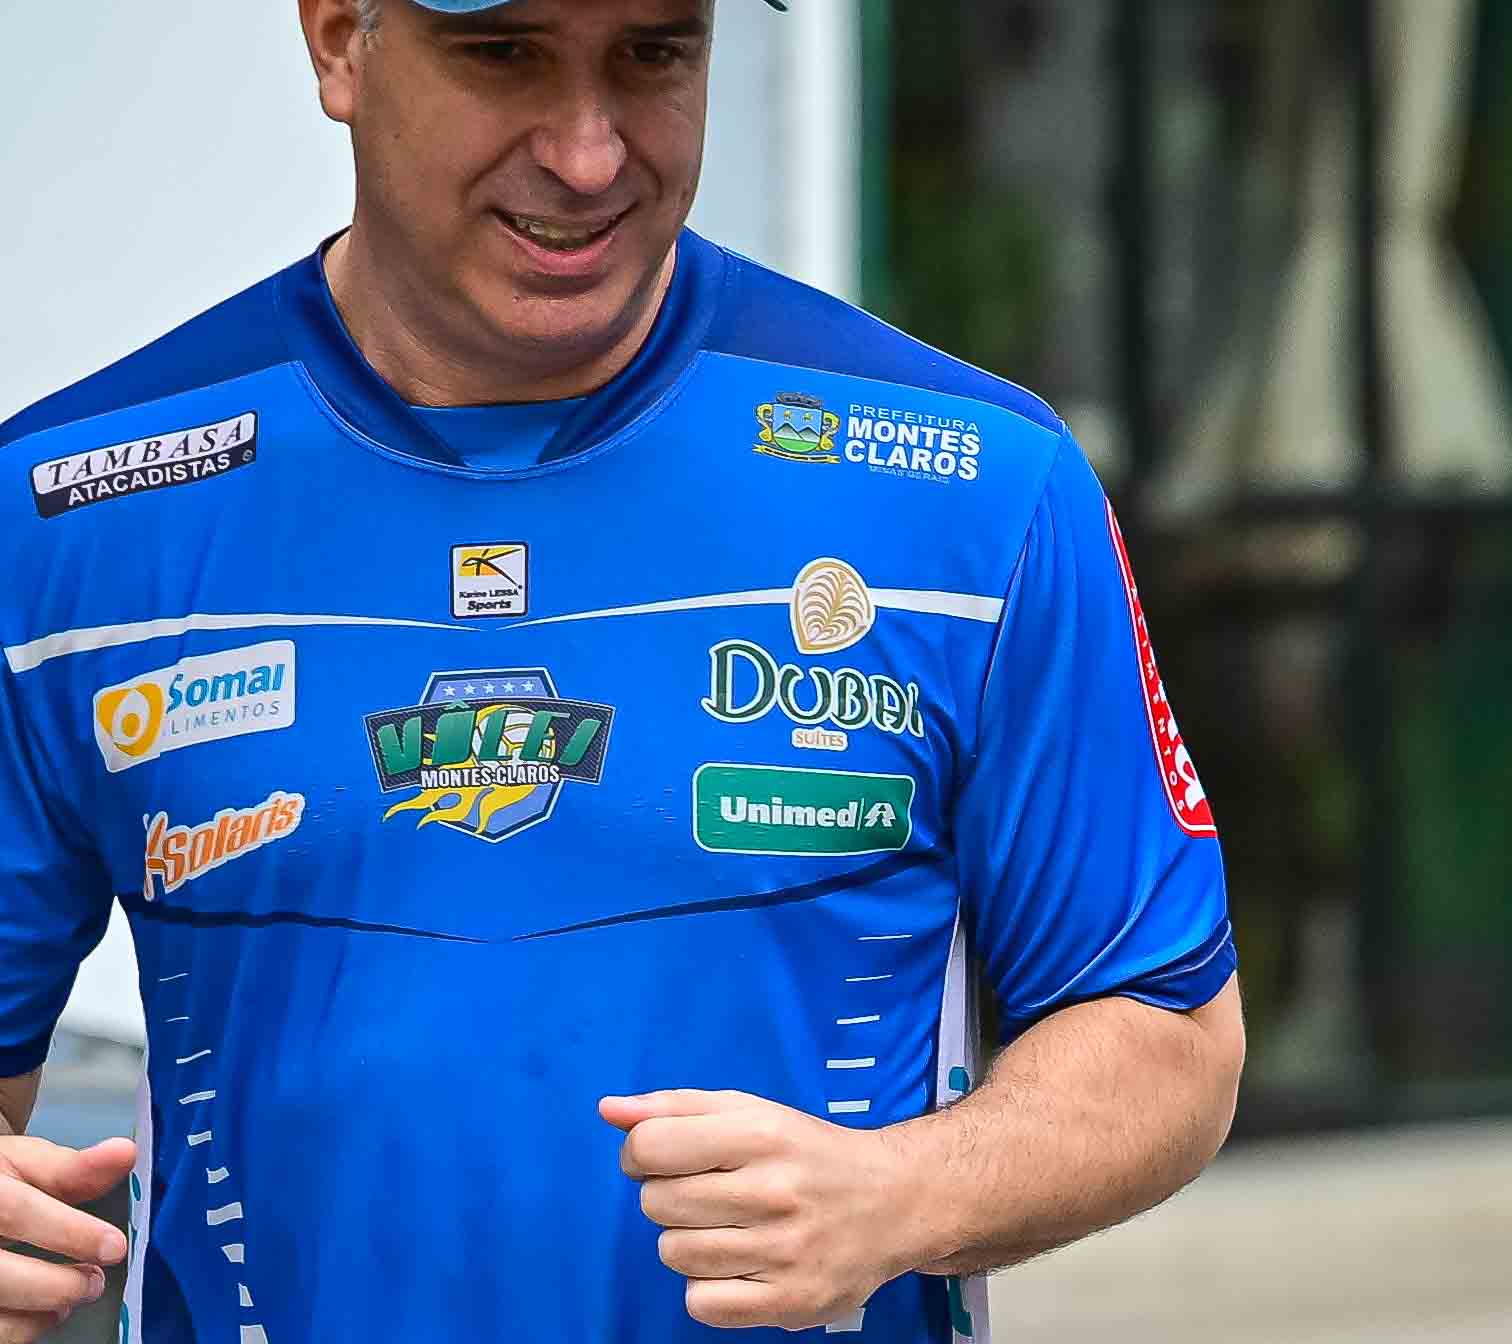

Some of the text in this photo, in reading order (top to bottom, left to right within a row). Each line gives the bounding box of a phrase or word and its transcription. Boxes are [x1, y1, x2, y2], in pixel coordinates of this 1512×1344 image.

[847, 415, 981, 456] MONTES
[849, 403, 979, 433] PREFEITURA
[48, 419, 243, 487] TAMBASA
[844, 439, 979, 481] CLAROS
[67, 453, 231, 506] ATACADISTAS
[467, 600, 512, 613] Sports
[163, 700, 281, 737] LIMENTOS
[420, 764, 561, 789] MONTES CLAROS
[720, 796, 858, 828] Unimed
